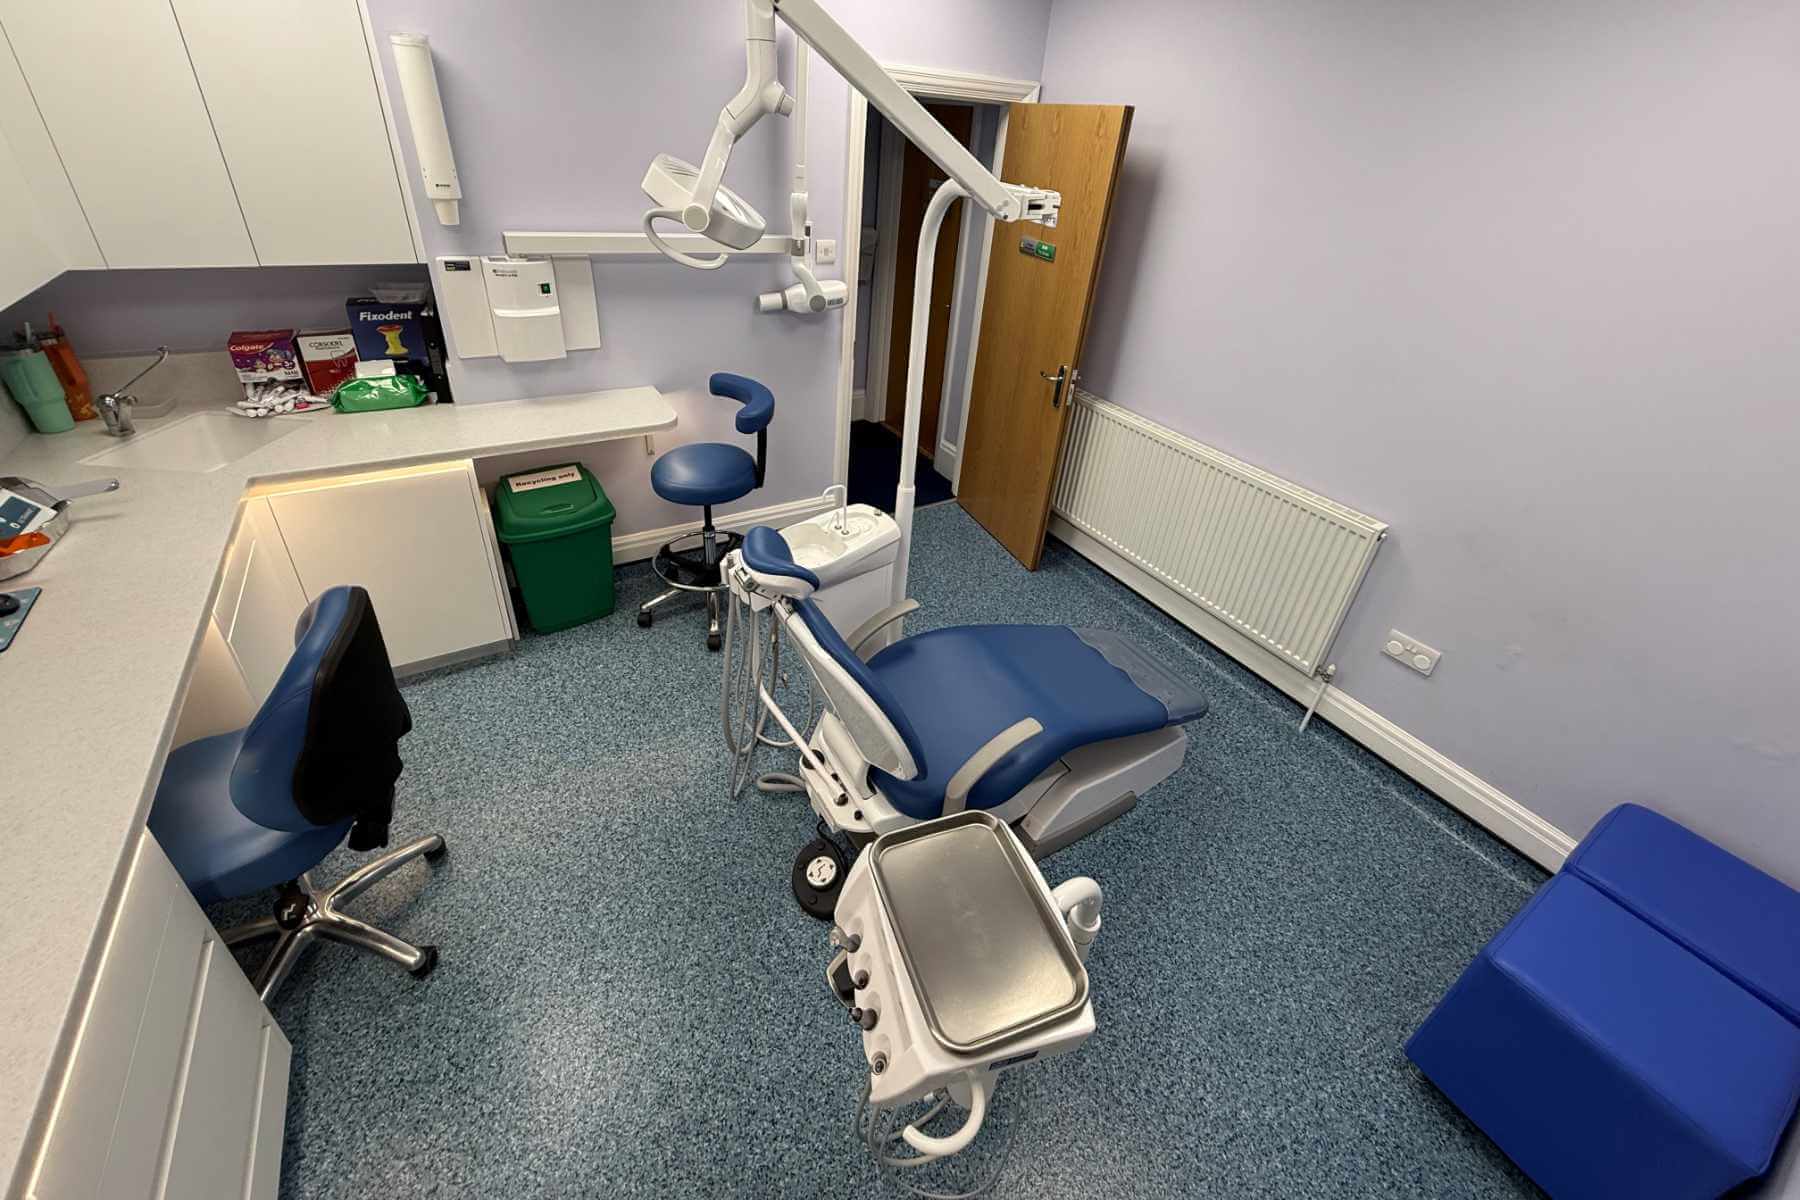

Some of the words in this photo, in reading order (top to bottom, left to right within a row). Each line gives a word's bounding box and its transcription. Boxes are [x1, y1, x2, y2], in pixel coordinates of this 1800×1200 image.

[359, 310, 412, 321] Fixodent
[230, 344, 264, 352] Colgate
[515, 476, 557, 486] Recycling
